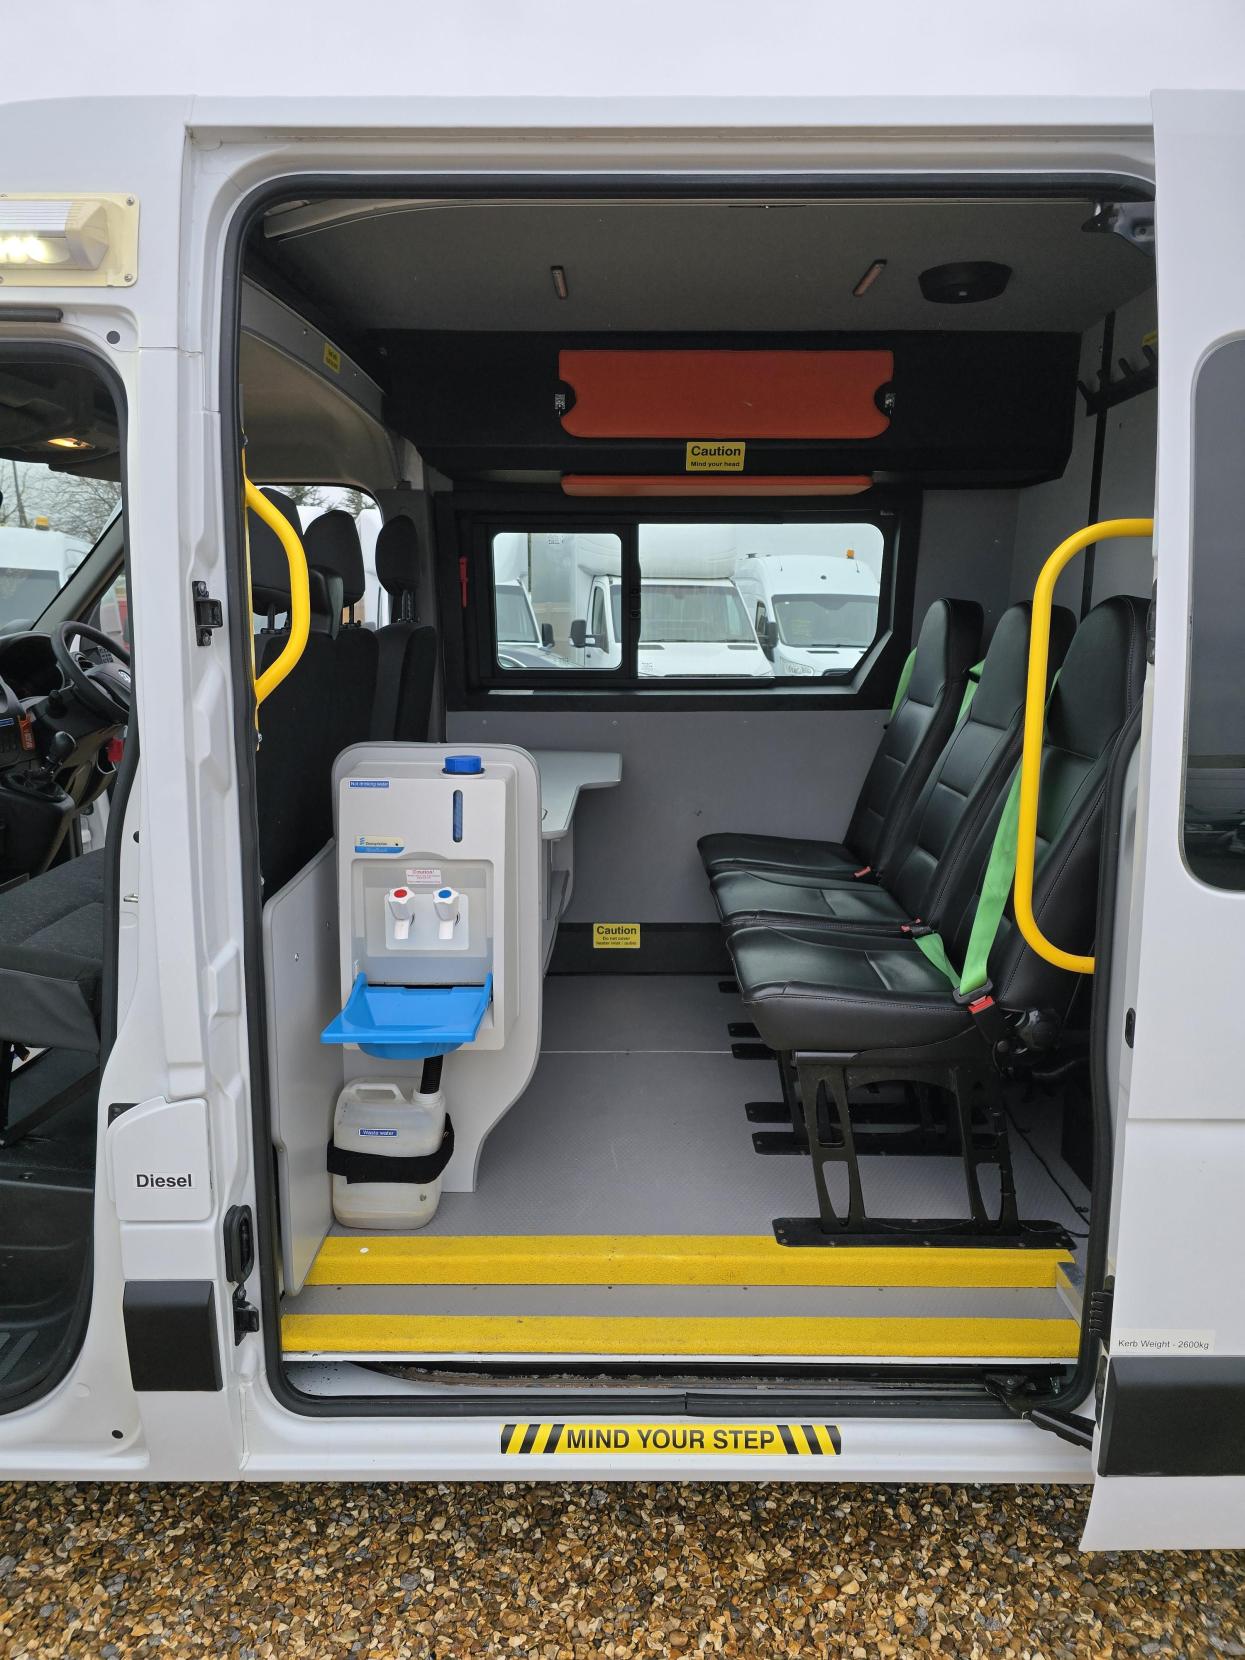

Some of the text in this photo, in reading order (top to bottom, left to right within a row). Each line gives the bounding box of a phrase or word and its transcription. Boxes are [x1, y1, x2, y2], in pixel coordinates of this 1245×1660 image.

[691, 446, 741, 456] Caution
[597, 925, 637, 935] Caution
[136, 1173, 192, 1188] Diesel
[1140, 1340, 1170, 1349] Weight
[1178, 1340, 1209, 1350] 2600kg
[566, 1429, 775, 1450] MIND YOUR STEP
